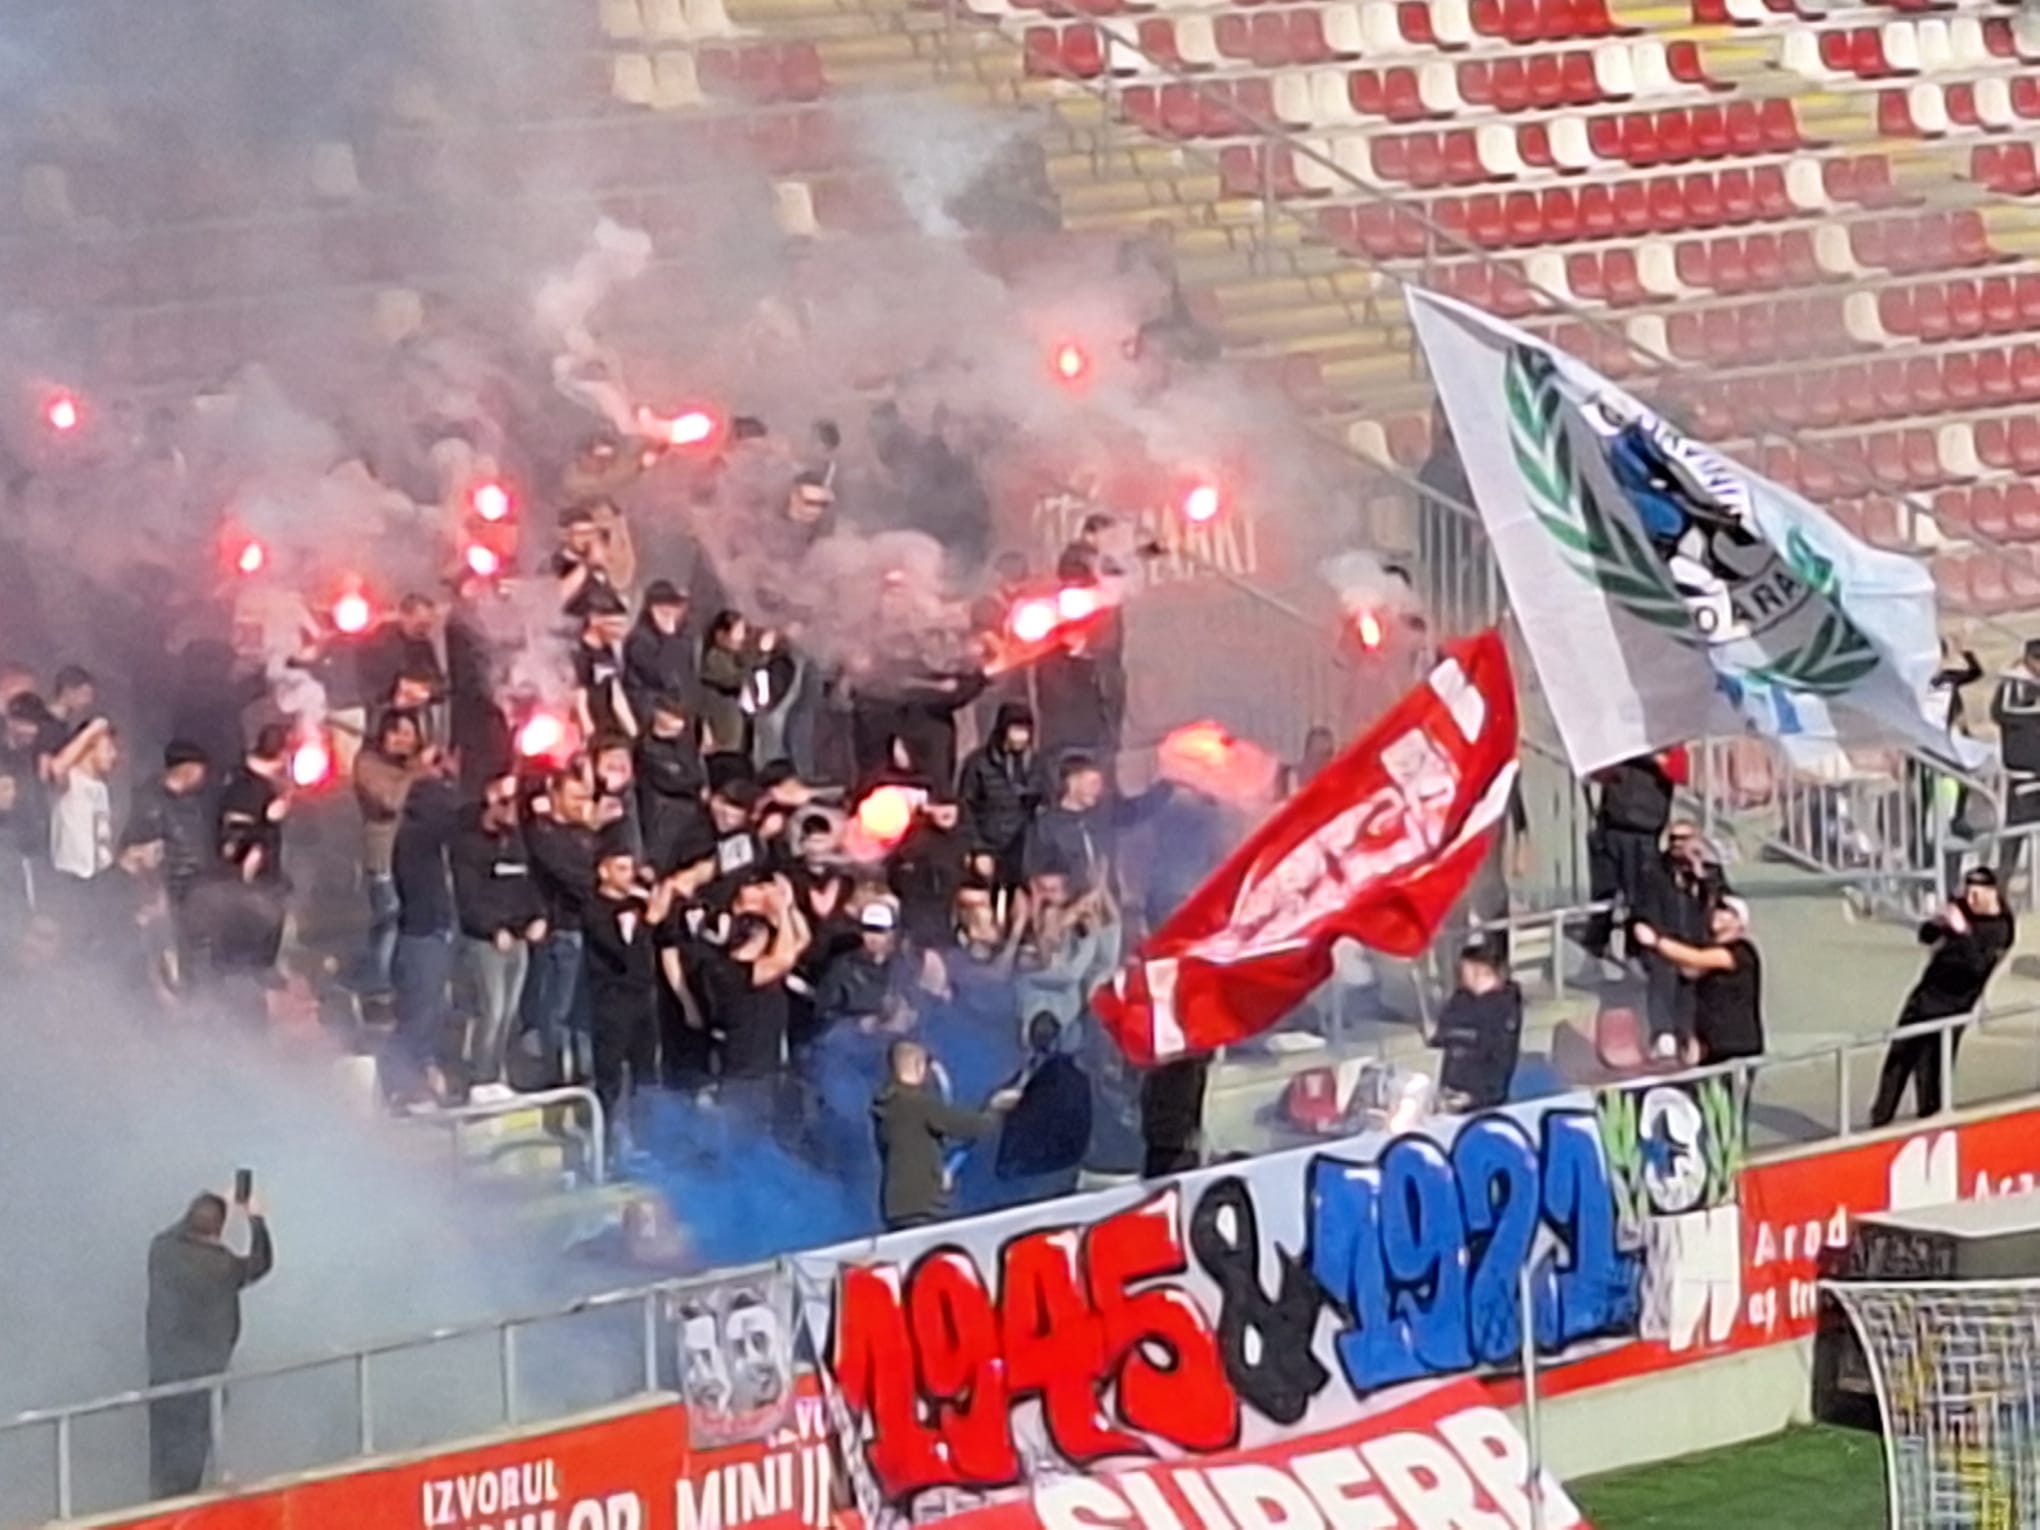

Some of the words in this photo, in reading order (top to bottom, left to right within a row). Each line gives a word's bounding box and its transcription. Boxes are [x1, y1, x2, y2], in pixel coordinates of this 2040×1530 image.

[826, 1182, 1242, 1503] 1945
[1189, 1175, 1334, 1424] &
[423, 1458, 559, 1527] IZVORUL
